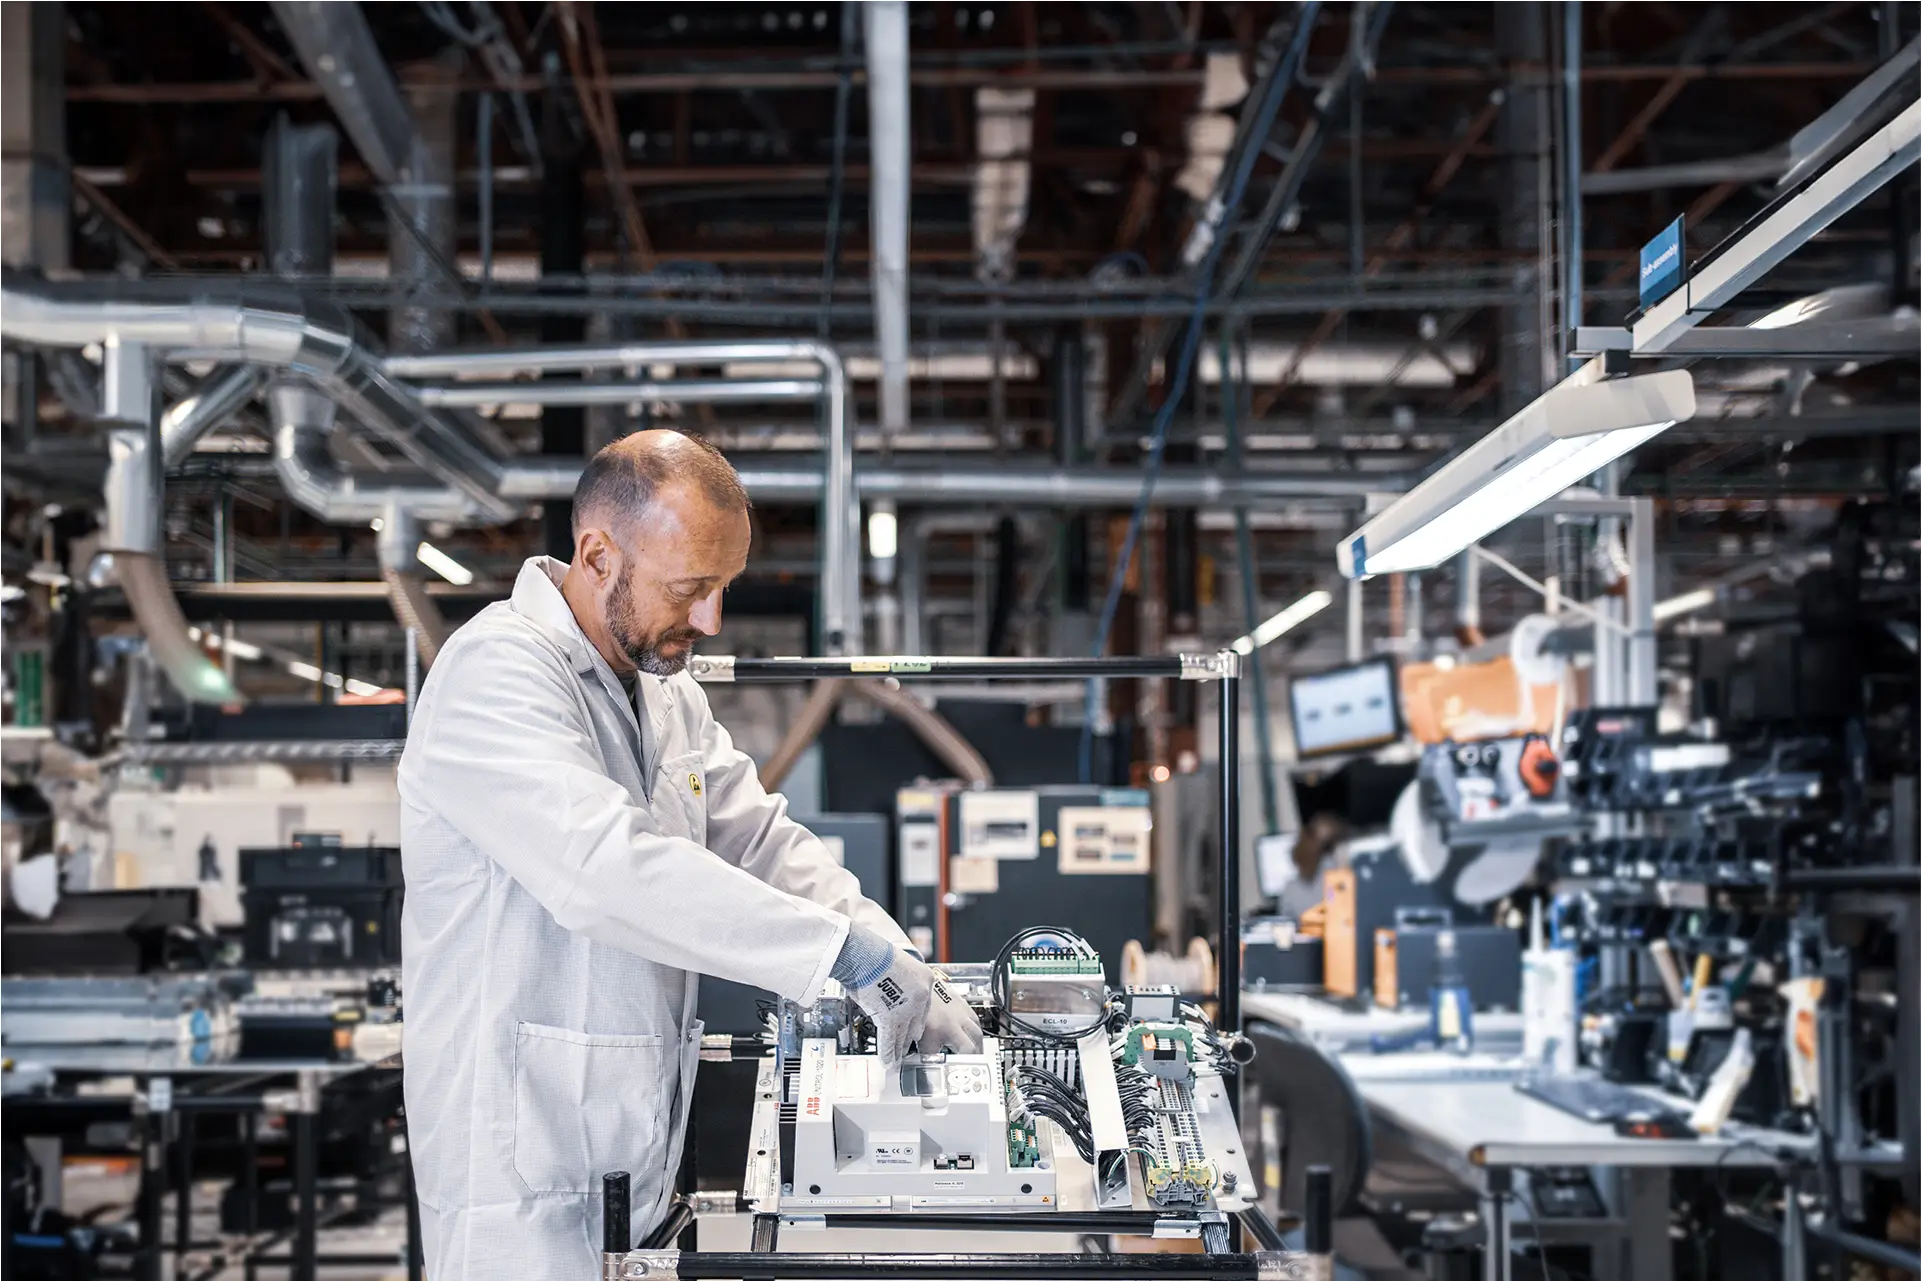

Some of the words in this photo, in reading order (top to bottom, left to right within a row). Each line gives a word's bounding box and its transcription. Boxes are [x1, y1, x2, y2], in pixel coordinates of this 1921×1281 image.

[877, 977, 901, 1003] JUBA
[934, 982, 952, 1004] JUBA
[806, 1096, 820, 1116] ABB
